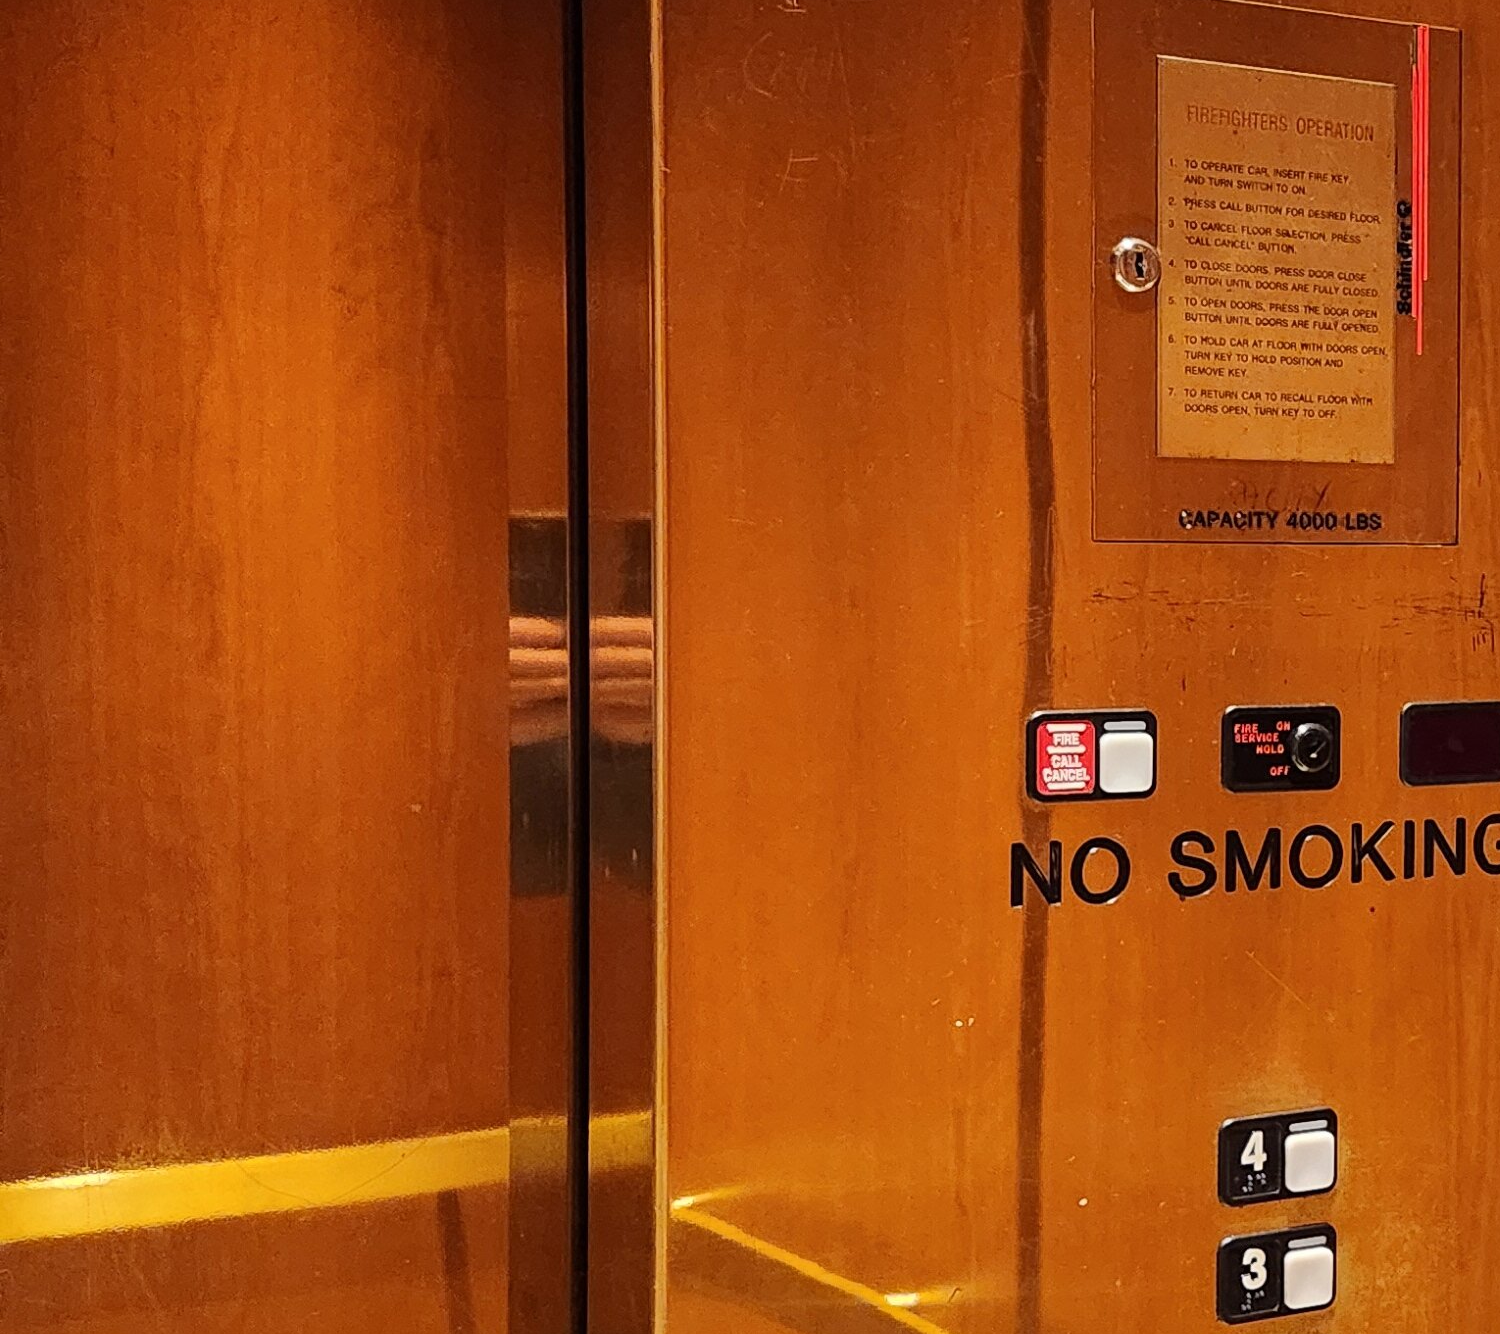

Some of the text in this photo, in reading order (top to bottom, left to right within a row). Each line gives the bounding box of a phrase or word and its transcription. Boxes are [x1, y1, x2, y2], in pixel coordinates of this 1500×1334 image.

[1296, 117, 1374, 141] OPERATION
[1184, 158, 1198, 169] TO
[1200, 160, 1243, 174] OPERATE
[1273, 168, 1305, 180] INSERT
[1309, 171, 1328, 182] FIRE
[1184, 175, 1205, 185] AND
[1209, 176, 1232, 188] TURN
[1236, 179, 1272, 191] SWITCH
[1276, 183, 1288, 193] TO
[1183, 197, 1216, 210] PRESS
[1219, 201, 1243, 212] CALL
[1245, 203, 1282, 215] BUTTON
[1286, 207, 1304, 218] FOR
[1308, 209, 1346, 221] DESIRED
[1184, 220, 1197, 230] TO
[1200, 221, 1237, 233] CANCEL
[1241, 225, 1271, 236] FLOOR
[1331, 231, 1362, 244] PRESS
[1184, 259, 1197, 269] TO
[1200, 260, 1231, 272] CLOSE
[1274, 266, 1304, 278] PRESS
[1308, 269, 1334, 280] DOOR
[1337, 271, 1367, 283] CLOSE
[1396, 219, 1412, 316] Schindler
[1184, 275, 1222, 286] BUTTON
[1226, 278, 1252, 289] UNTIL
[1255, 281, 1288, 292] DOORS
[1291, 283, 1309, 293] ARE
[1313, 285, 1339, 296] FULLY
[1184, 297, 1197, 307] TO
[1200, 298, 1227, 309] OPEN
[1230, 300, 1266, 312] DOORS,
[1269, 303, 1299, 314] PRESS
[1303, 305, 1320, 315] THE
[1323, 306, 1349, 317] DOOR
[1352, 308, 1378, 319] OPEN
[1184, 312, 1222, 324] BUTTON
[1226, 316, 1252, 326] UNTIL
[1255, 317, 1288, 328] DOORS
[1291, 320, 1309, 329] ARE
[1313, 321, 1338, 332] FULLY
[1184, 335, 1197, 345] TO
[1200, 336, 1226, 347] HOLD
[1230, 338, 1249, 348] CAR
[1251, 340, 1263, 348] AT
[1266, 340, 1297, 351] FLOOR
[1300, 343, 1323, 353] WITH
[1326, 344, 1358, 355] DOORS
[1184, 350, 1343, 369] TURN KEY TO HOLD POSITION AND
[1184, 366, 1225, 377] REMOVE
[1184, 388, 1197, 398] TO
[1200, 389, 1238, 400] RETURN
[1241, 391, 1261, 401] CAR
[1264, 393, 1278, 402] TO
[1280, 394, 1314, 404] RECALL
[1317, 395, 1348, 405] FLOOR
[1350, 395, 1373, 407] WITH
[1184, 403, 1218, 414] DOORS
[1253, 407, 1279, 416] TURN
[1281, 408, 1299, 418] KEY
[1303, 410, 1315, 419] TO
[1178, 509, 1382, 531] CAPACITY 4000 LBS
[1234, 723, 1259, 734] FIRE
[1276, 720, 1291, 732] ON
[1052, 731, 1080, 746] FIRE
[1234, 732, 1279, 744] SERVICE
[1255, 743, 1285, 755] HOLD
[1050, 753, 1082, 768] CALL
[1042, 767, 1090, 783] CANCEL
[1010, 836, 1132, 910] NO
[1240, 1130, 1267, 1172] 4
[1240, 1247, 1267, 1291] 3
